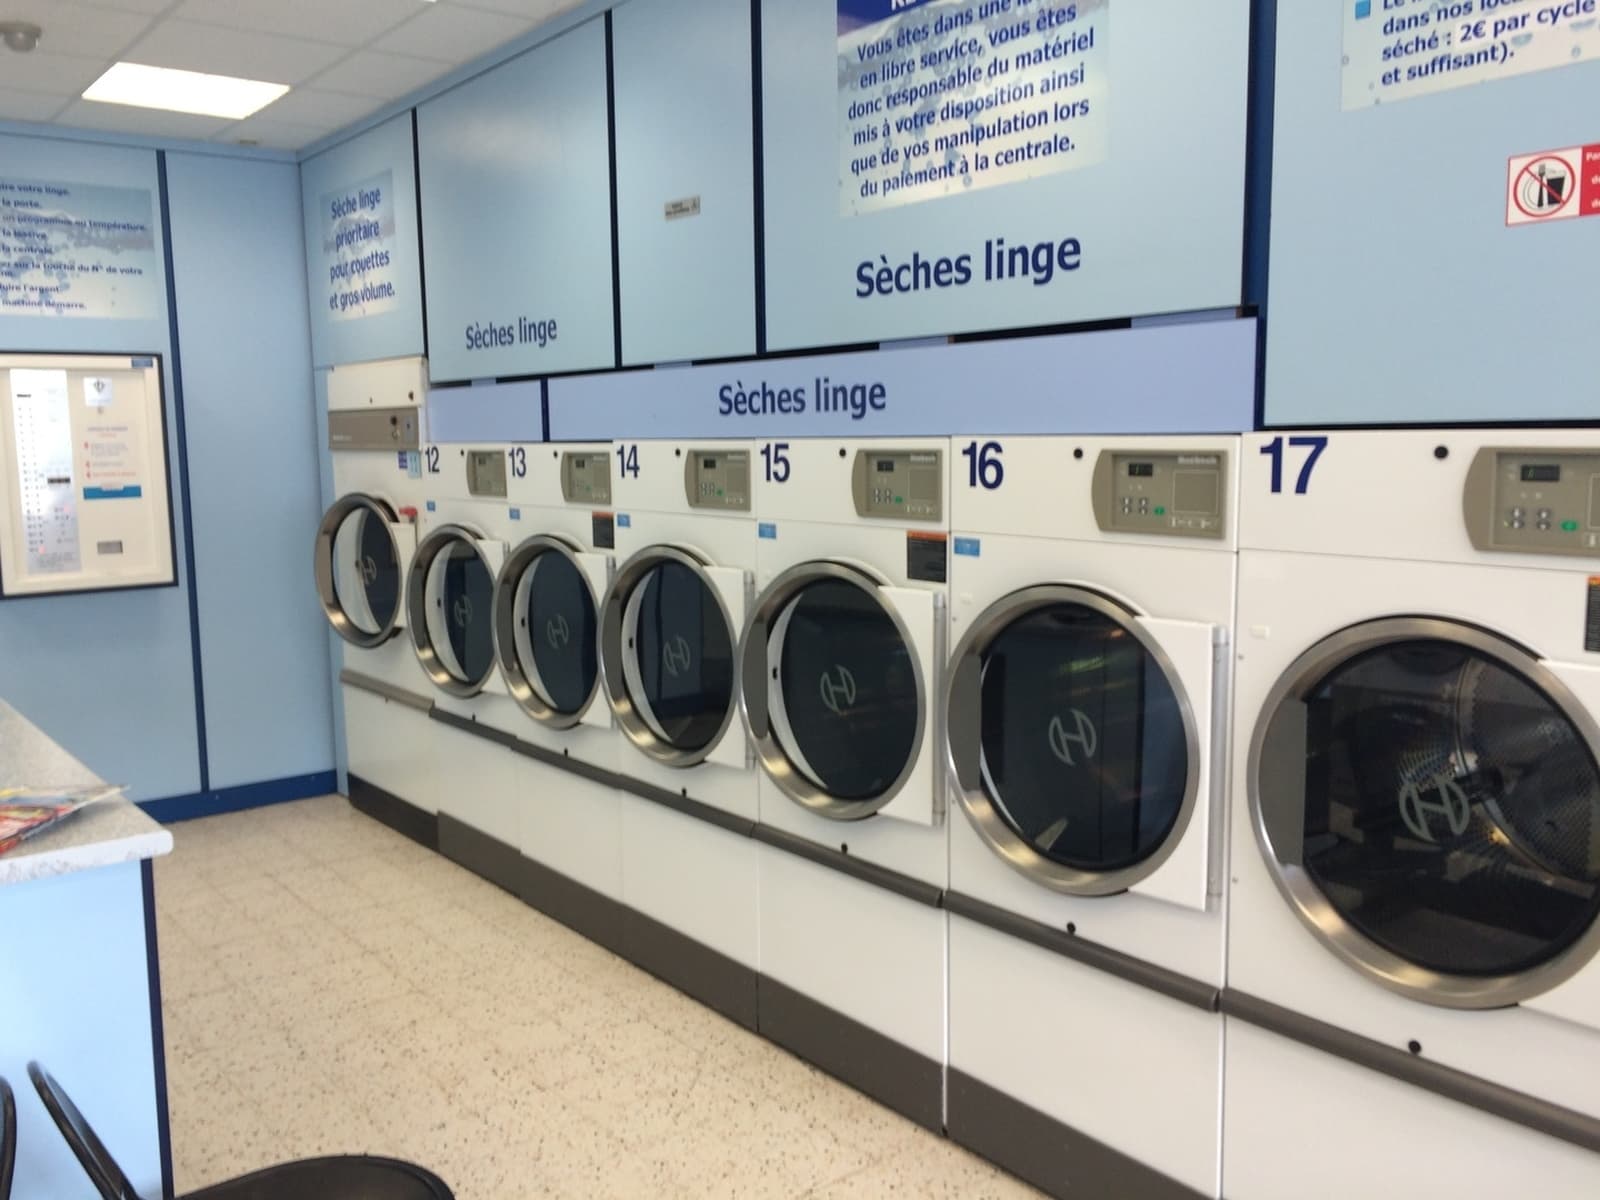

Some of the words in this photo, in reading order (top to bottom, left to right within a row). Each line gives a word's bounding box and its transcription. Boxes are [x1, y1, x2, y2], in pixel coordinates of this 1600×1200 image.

[857, 38, 892, 63] Vous
[896, 24, 929, 49] êtes
[934, 9, 973, 36] dans
[979, 0, 1011, 19] une
[1382, 31, 1439, 61] séché
[1460, 21, 1486, 42] 2€
[1493, 13, 1530, 38] par
[1537, 0, 1595, 25] cycle
[1383, 12, 1429, 35] dans
[1437, 2, 1472, 22] nos
[860, 72, 877, 89] en
[881, 56, 915, 83] libre
[920, 37, 984, 67] service,
[989, 19, 1030, 47] vous
[1036, 5, 1076, 33] êtes
[1381, 66, 1401, 85] et
[1407, 41, 1514, 81] suffisant).
[848, 98, 882, 120] donc
[886, 67, 982, 107] responsable
[988, 57, 1009, 78] du
[1015, 26, 1094, 67] matériel
[853, 123, 878, 146] mis
[882, 118, 891, 139] à
[895, 109, 935, 134] votre
[940, 80, 1034, 122] disposition
[1040, 62, 1085, 95] ainsi
[851, 154, 877, 176] que
[881, 148, 899, 165] de
[904, 140, 929, 161] vos
[934, 110, 1048, 149] manipulation
[1053, 98, 1089, 122] lors
[860, 177, 878, 198] du
[882, 159, 955, 196] paiement
[959, 155, 969, 175] à
[975, 153, 989, 171] la
[995, 134, 1075, 167] centrale.
[331, 195, 357, 219] Sèche
[359, 188, 381, 211] linge
[336, 221, 380, 252] prioritaire
[330, 264, 349, 283] pour
[351, 249, 390, 275] couettes
[856, 251, 972, 298] Sèches
[985, 237, 1081, 286] linge
[330, 292, 338, 310] et
[340, 289, 358, 312] gros
[360, 281, 395, 303] volume.
[465, 321, 514, 350] Sèches
[519, 316, 557, 348] linge
[719, 380, 806, 416] Sèches
[815, 377, 887, 420] linge
[425, 446, 440, 473] 12
[508, 447, 527, 477] 13
[617, 444, 640, 479] 14
[760, 443, 791, 482] 15
[962, 441, 1004, 489] 16
[1260, 436, 1329, 494] 17
